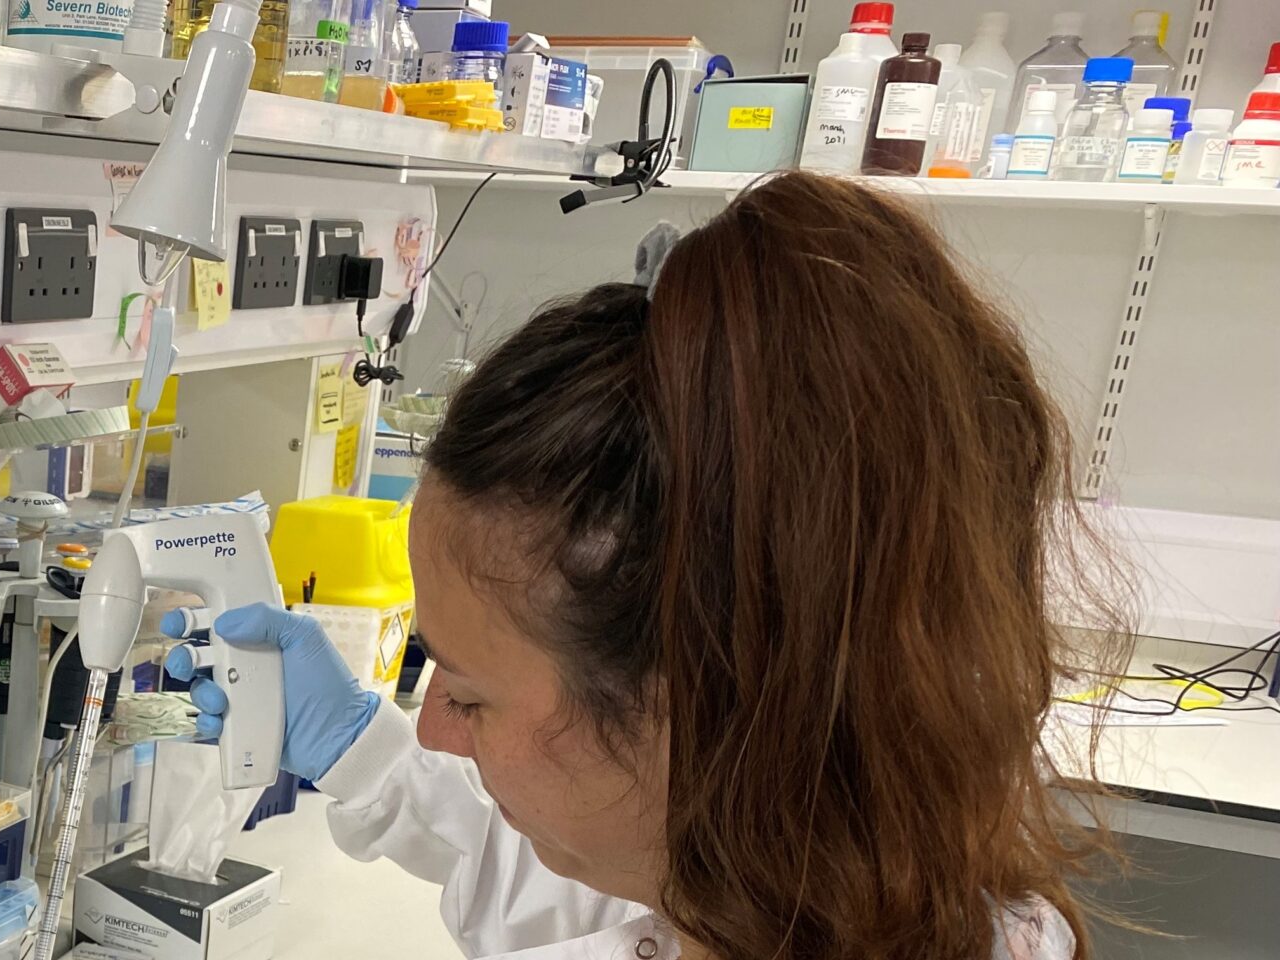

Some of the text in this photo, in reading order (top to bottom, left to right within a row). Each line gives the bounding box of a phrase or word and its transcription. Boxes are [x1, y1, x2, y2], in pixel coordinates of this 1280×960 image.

[46, 0, 92, 14] Severn
[374, 447, 420, 459] eppendo
[155, 532, 235, 551] Powerpette
[214, 546, 236, 557] Pro
[104, 915, 145, 934] KIMTECH
